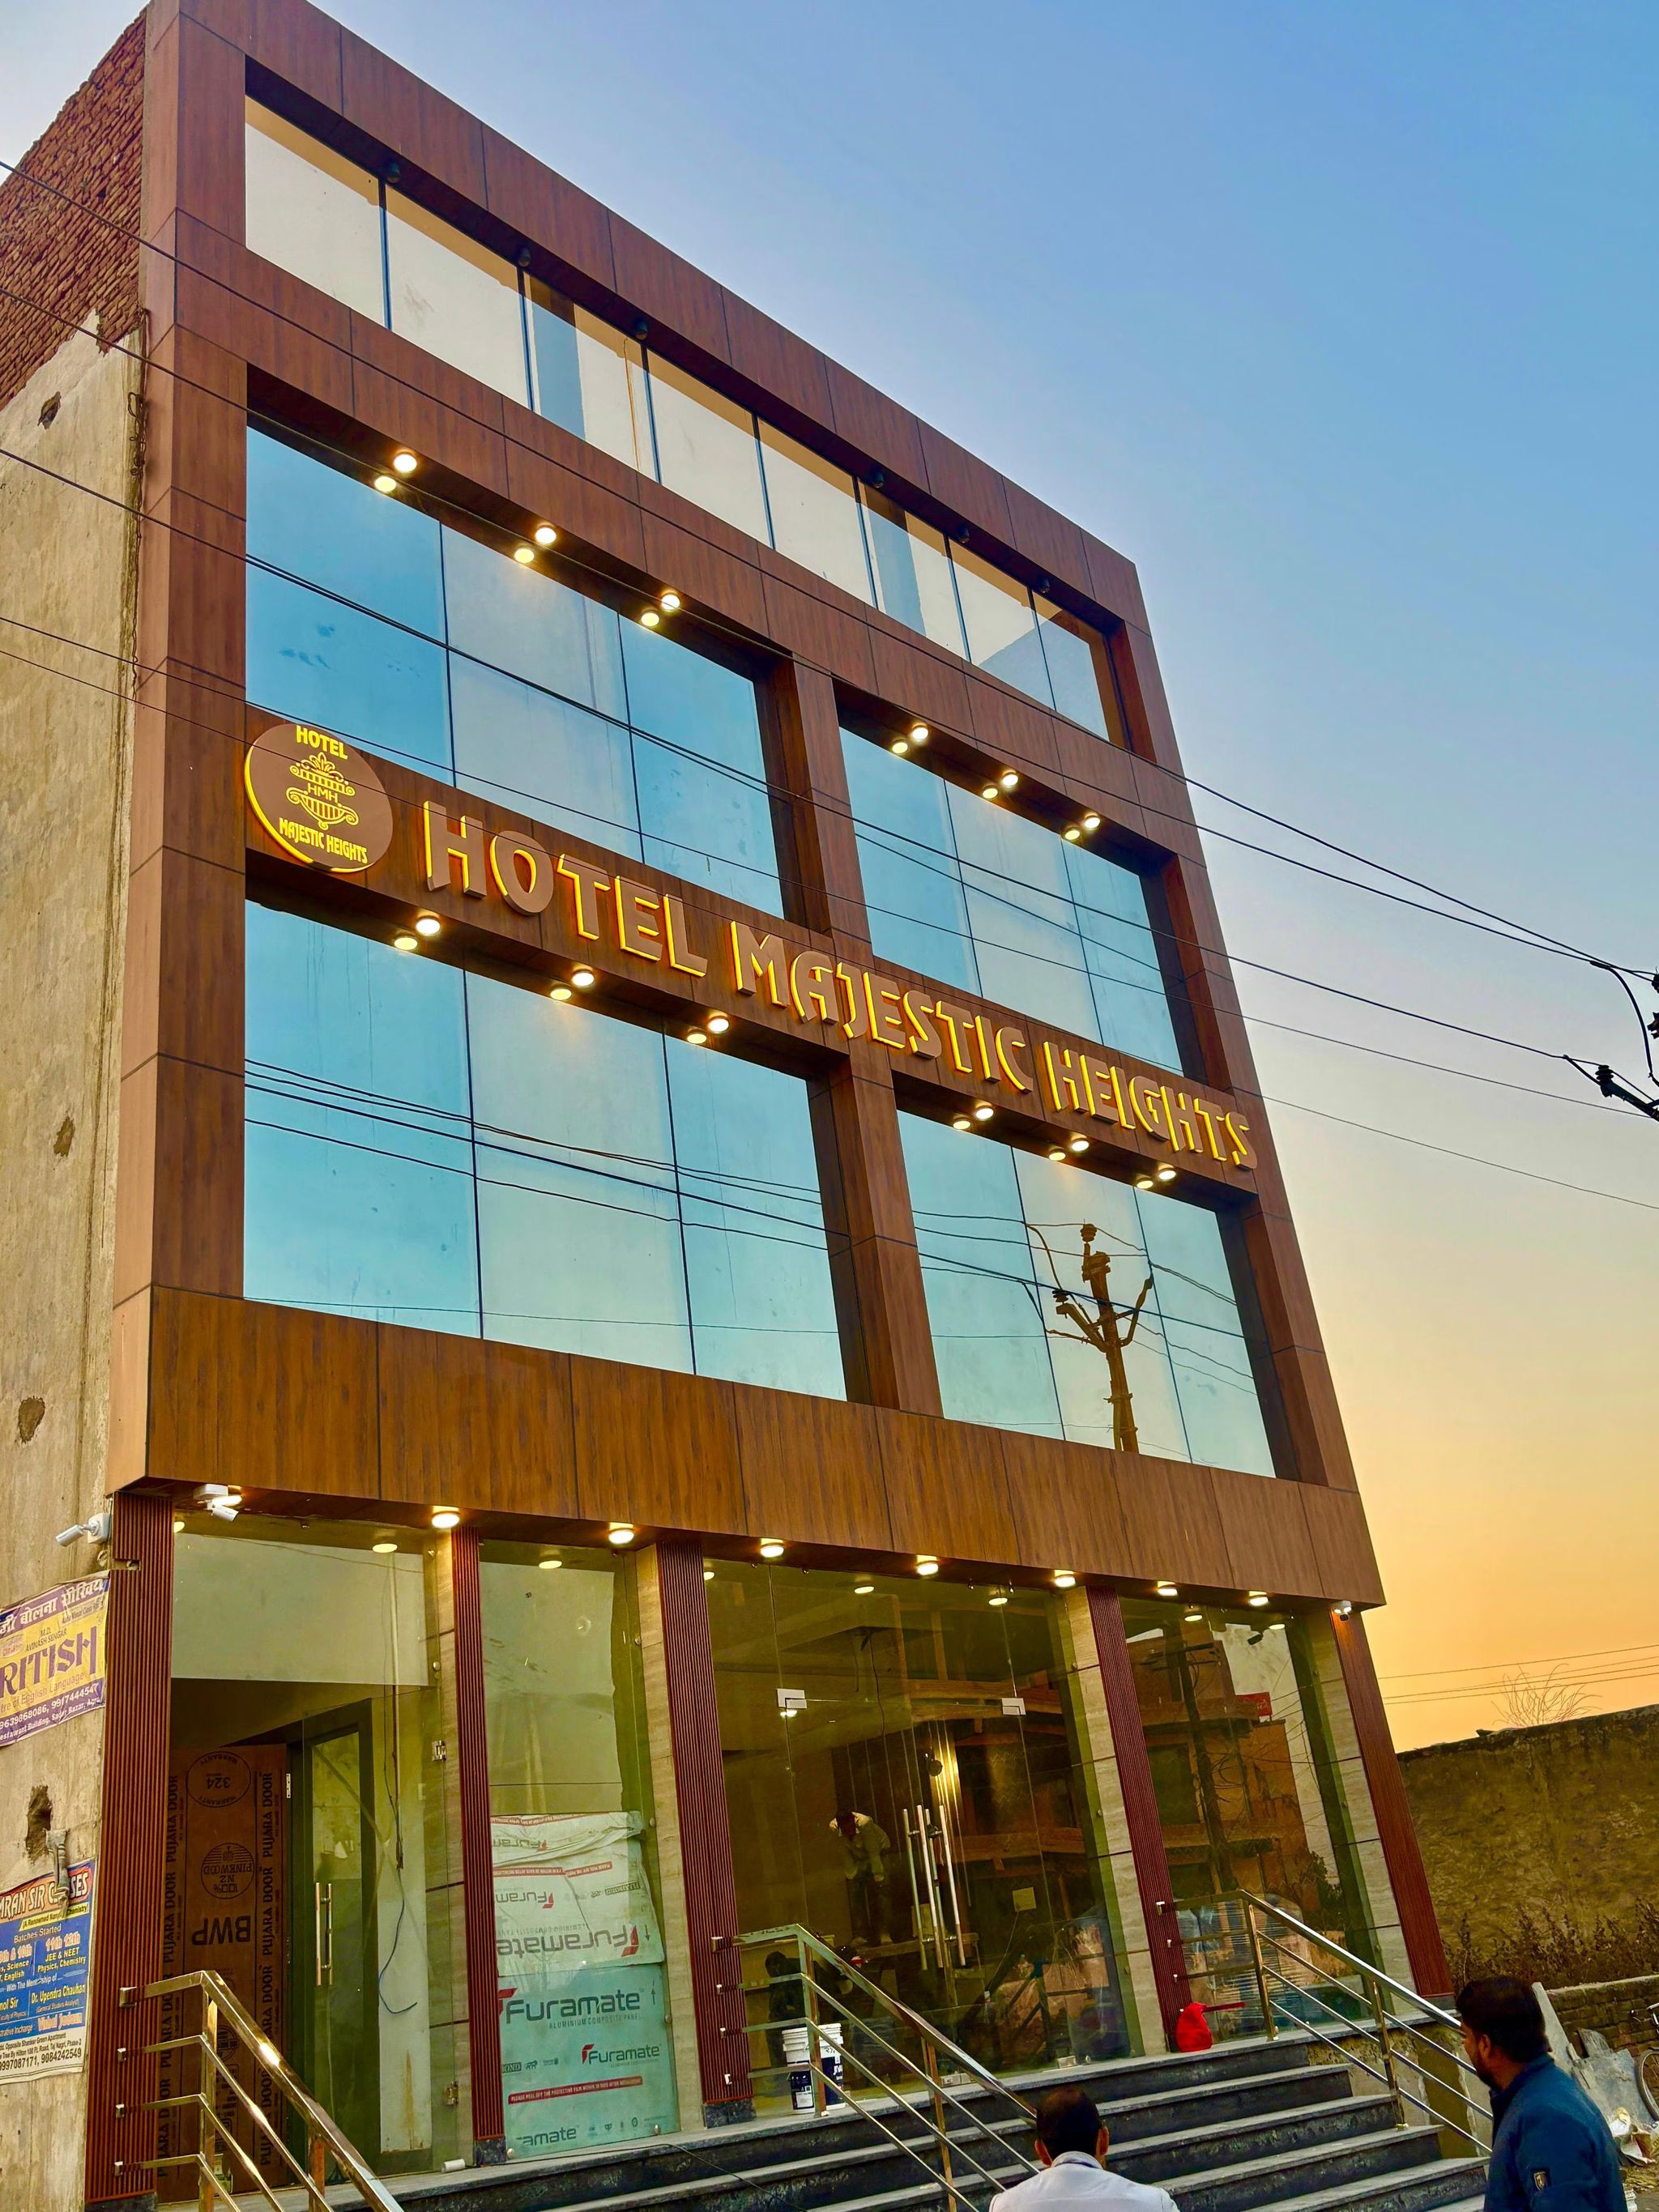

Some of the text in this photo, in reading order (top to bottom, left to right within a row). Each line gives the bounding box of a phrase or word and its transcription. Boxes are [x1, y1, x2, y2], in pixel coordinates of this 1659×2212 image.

[296, 725, 348, 760] HOTEL
[307, 782, 339, 803] HMH
[279, 817, 369, 864] MAJESTIC HEIGHTS
[423, 800, 1258, 1170] HOTEL MAJESTIC HEIGHTS
[20, 1597, 58, 1625] बोलना
[21, 1686, 47, 1705] English
[49, 1672, 84, 1692] Language
[207, 1777, 231, 1789] 324
[167, 1775, 178, 1863] PUJARA DOOR
[262, 1772, 275, 1858] PUJARA DOOR
[28, 1885, 45, 1910] SIR
[164, 1871, 176, 1908] DOOR
[262, 1867, 275, 1956] PUJARA DOOR
[14, 1923, 62, 1943] Batches Started
[192, 1916, 251, 1946] BWP
[497, 1924, 628, 1958] Furamate
[6, 1960, 29, 1971] Science
[37, 1956, 87, 1973] Physics, Chemistry
[45, 1952, 57, 1963] JEE
[63, 1946, 79, 1958] NEET
[4, 1970, 25, 1981] English
[262, 1965, 273, 2003] DOOR
[10, 1997, 19, 2009] Sir
[40, 1988, 62, 2004] Upendra
[63, 1983, 86, 1996] Chauhan
[506, 1989, 640, 2024] Furamate
[548, 2018, 586, 2030] ALUMINIUM
[587, 2015, 623, 2026] COMPOSITE
[41, 2048, 82, 2064] 9084242549
[589, 2044, 660, 2065] Furamate
